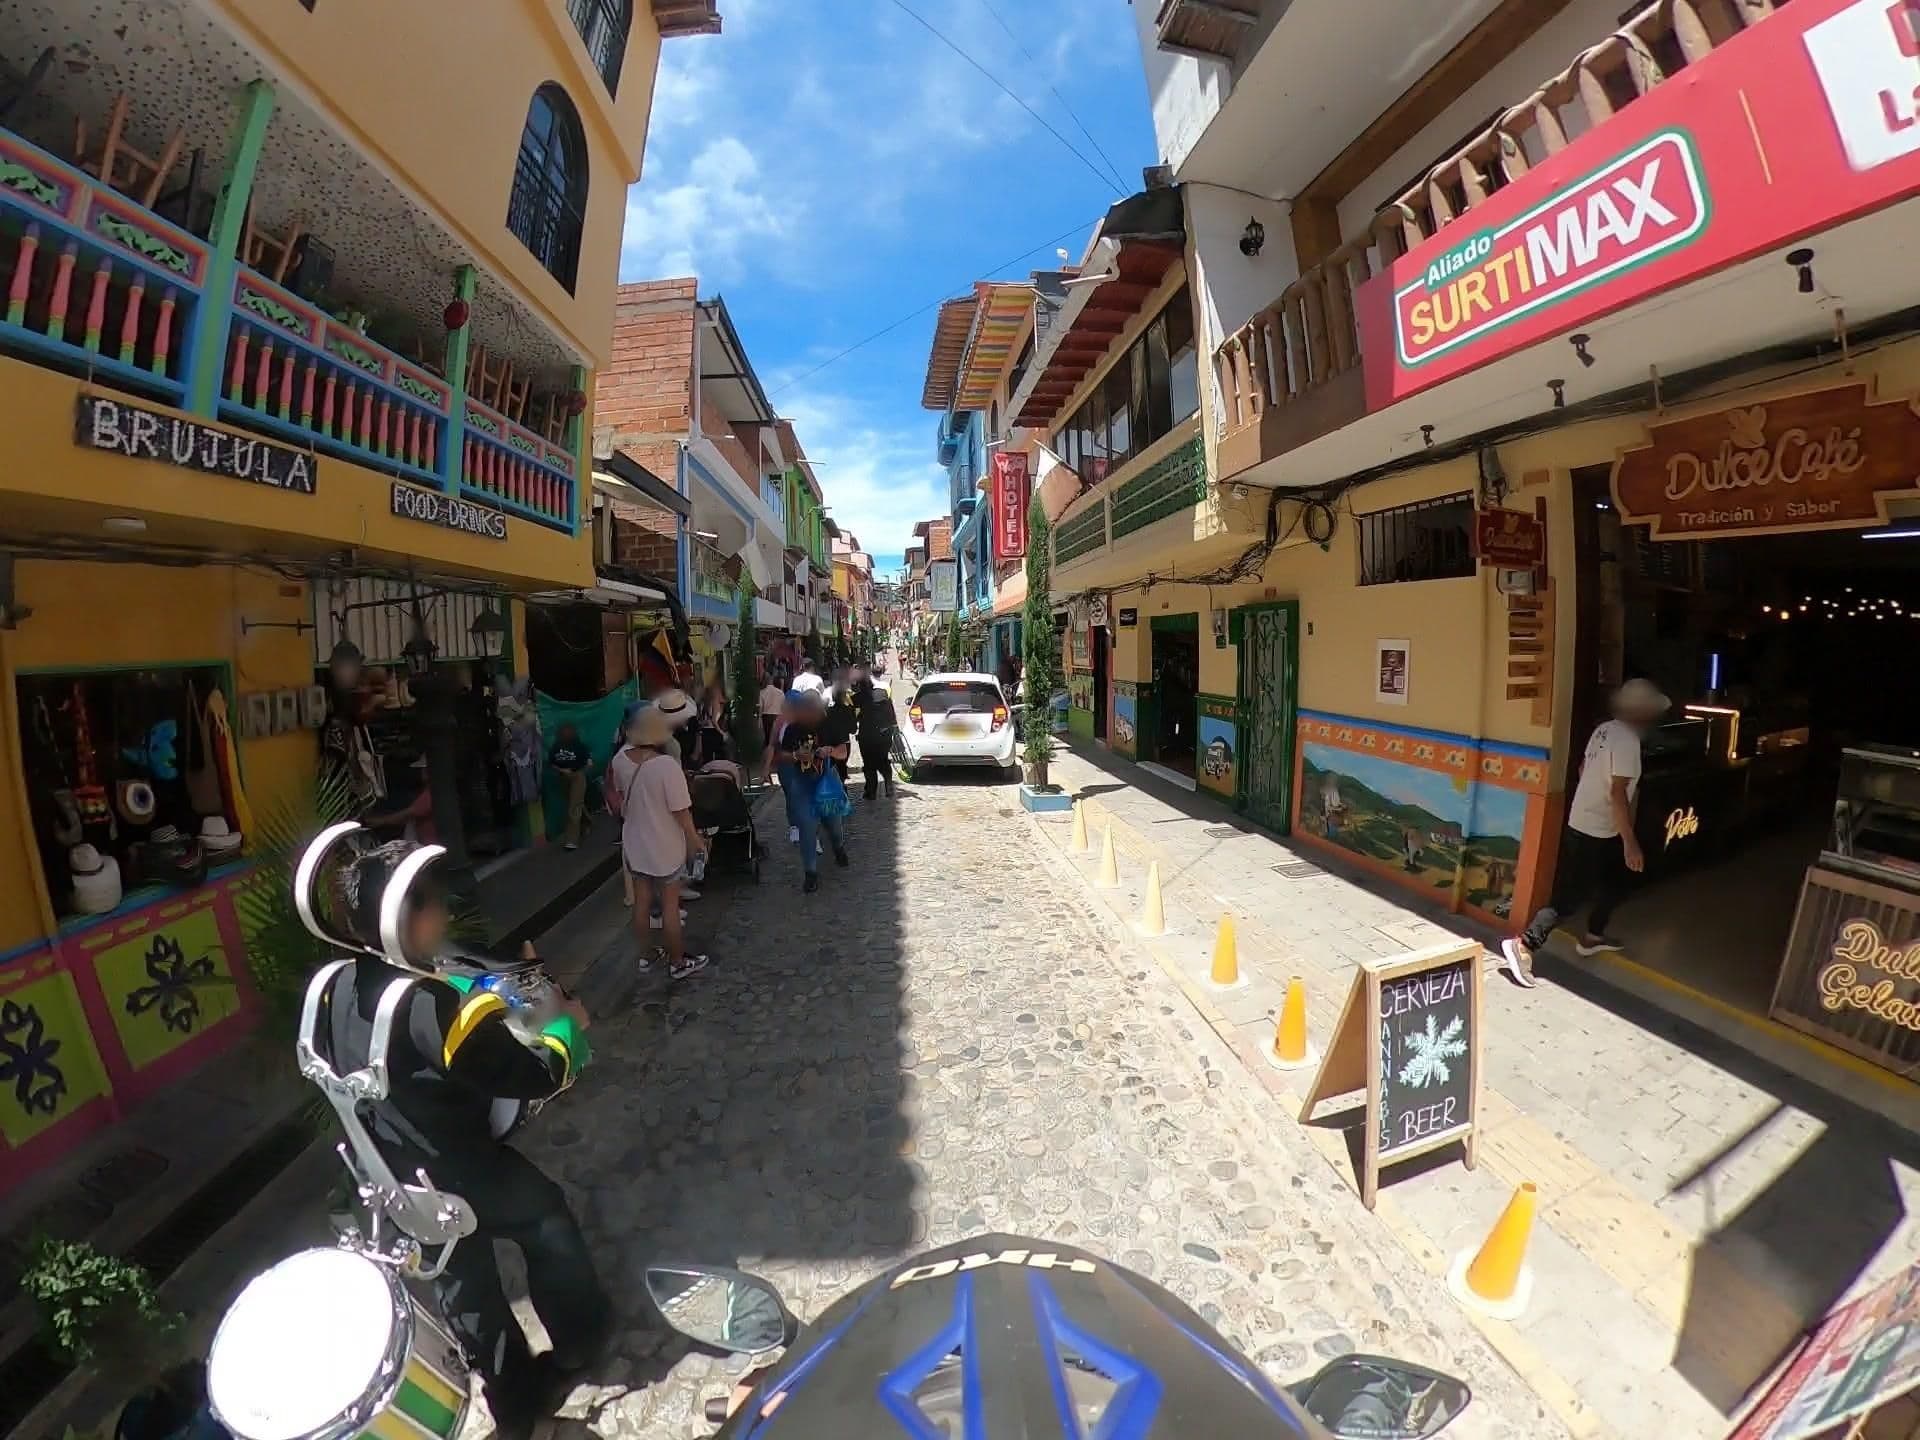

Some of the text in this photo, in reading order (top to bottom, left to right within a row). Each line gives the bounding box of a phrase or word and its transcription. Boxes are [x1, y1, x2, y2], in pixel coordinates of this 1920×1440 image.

[1408, 157, 1679, 346] SURTIMAX
[1427, 234, 1492, 286] Aliado
[92, 399, 312, 492] BRUJULA
[1004, 475, 1019, 547] HOTEL
[1678, 500, 1841, 527] Tradición y Sabor
[1380, 968, 1466, 1019] CERVEZA
[1399, 1096, 1457, 1144] BEER
